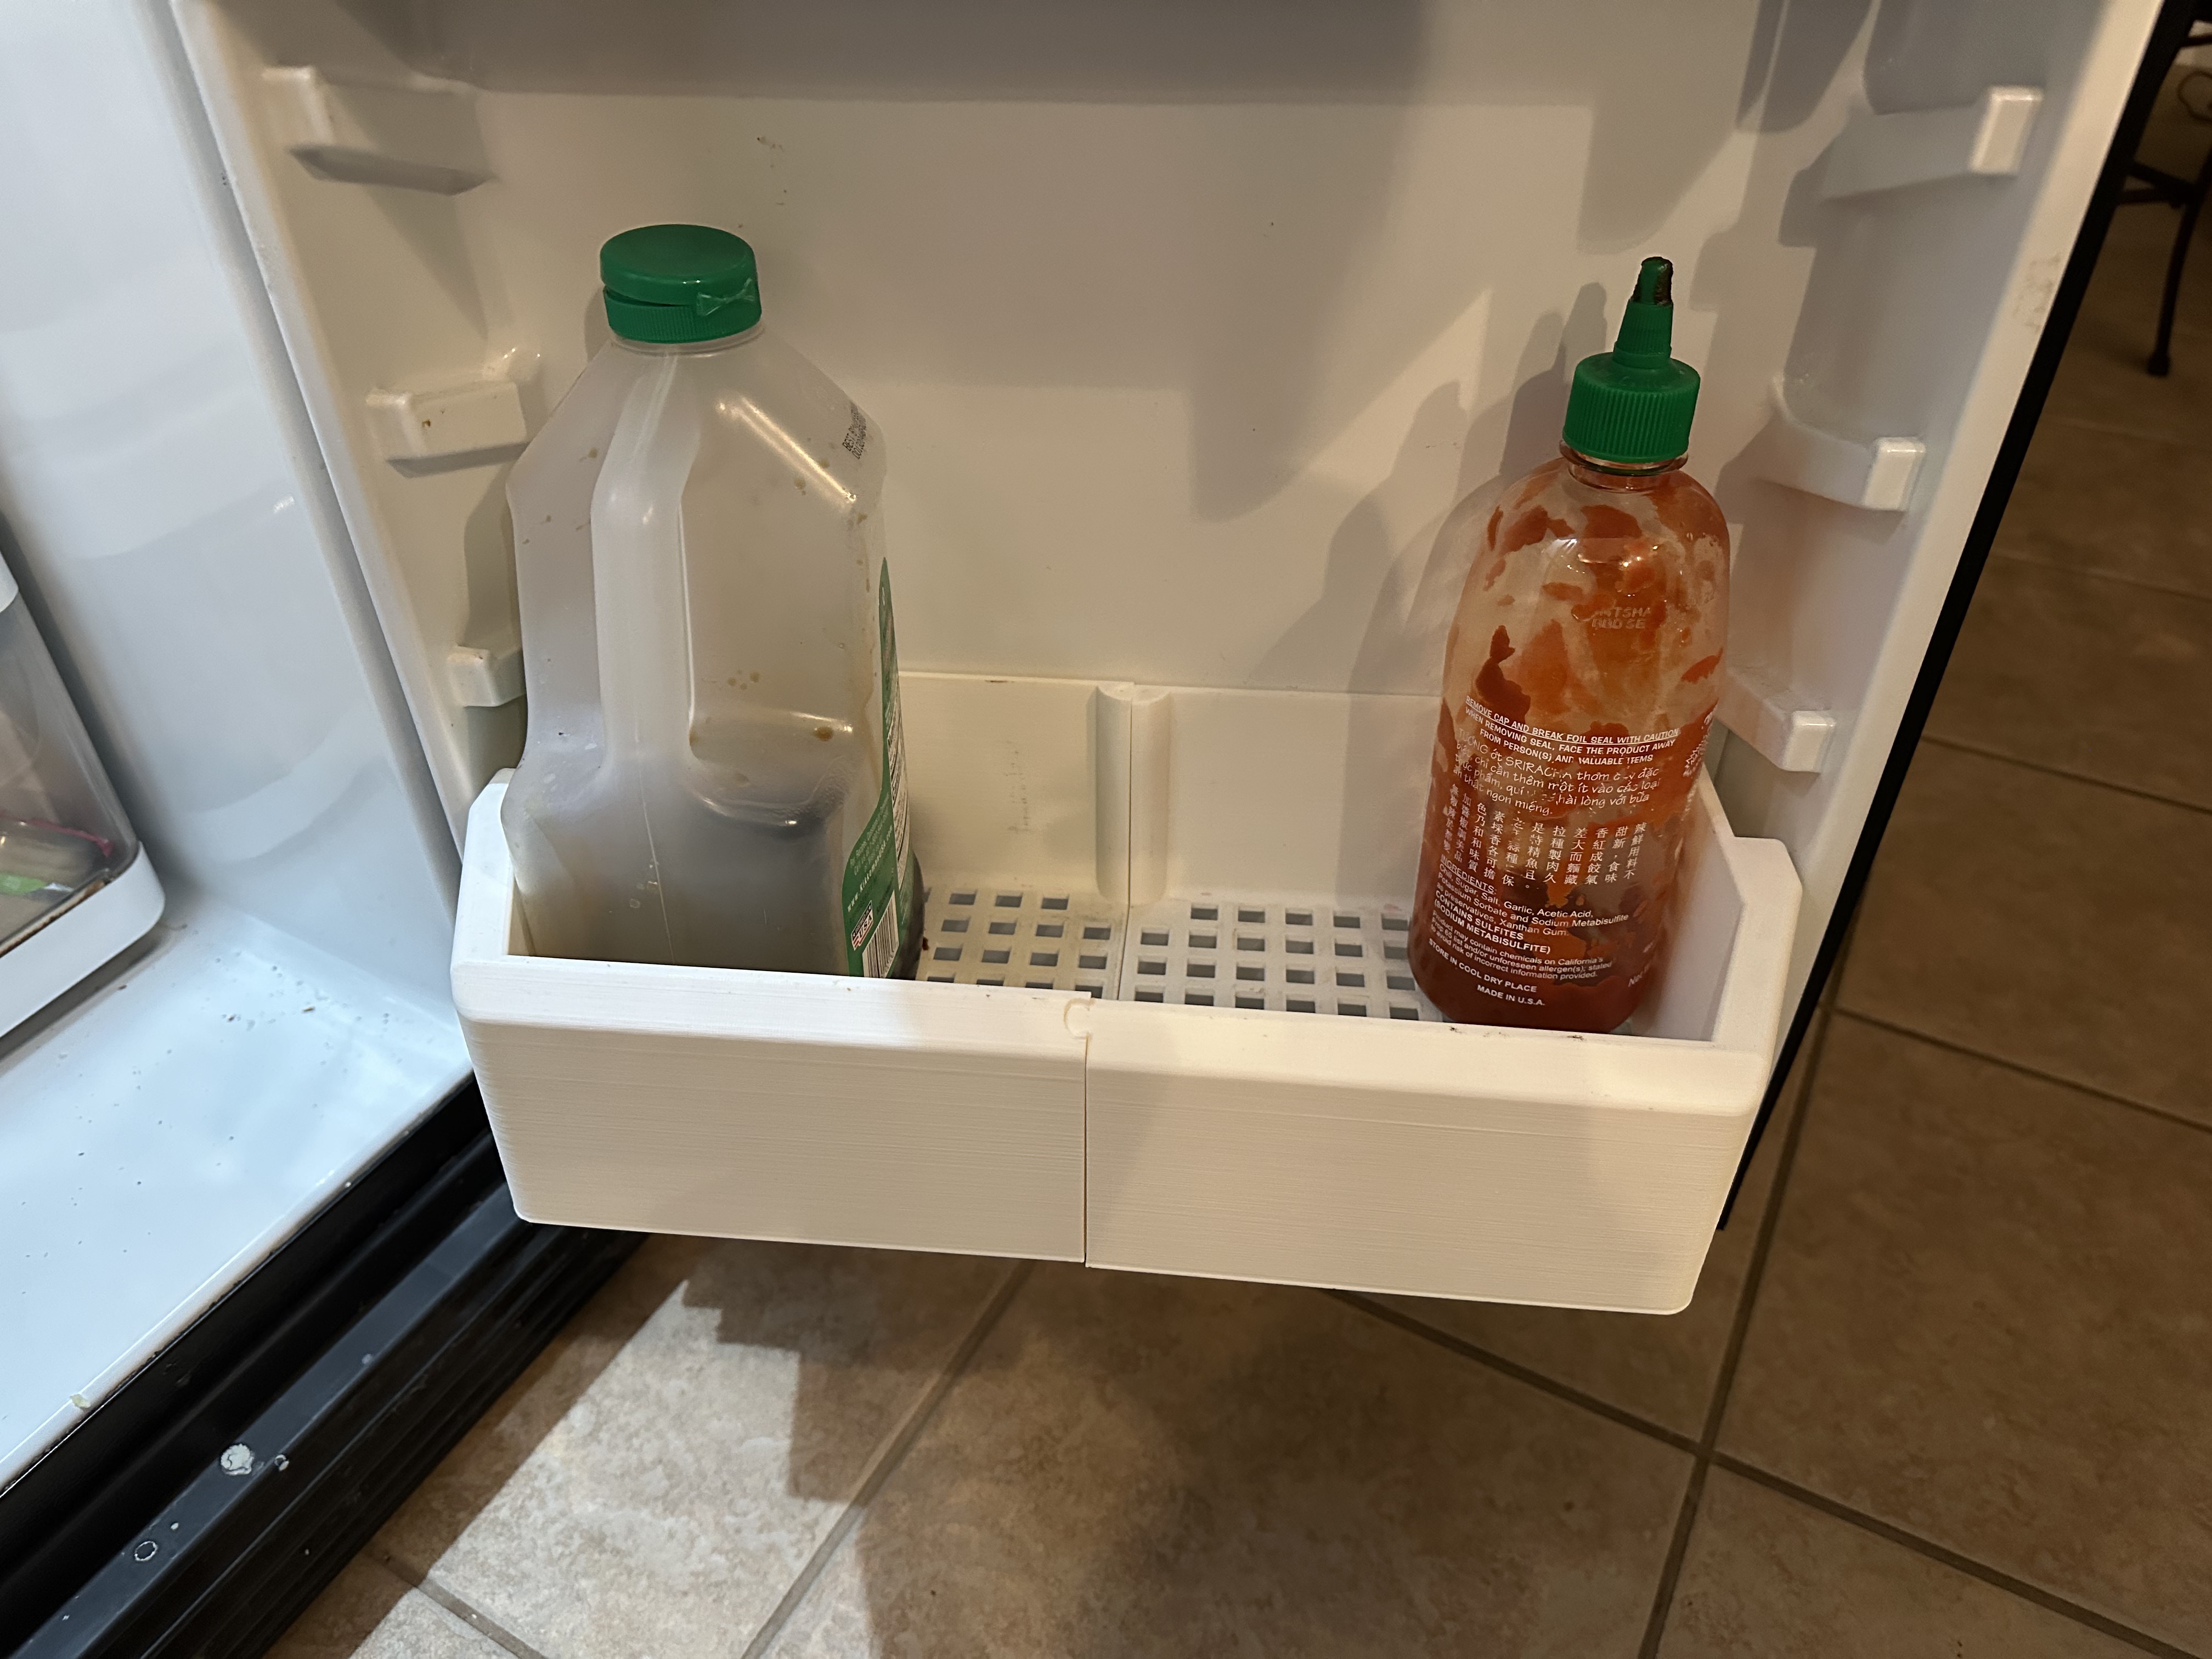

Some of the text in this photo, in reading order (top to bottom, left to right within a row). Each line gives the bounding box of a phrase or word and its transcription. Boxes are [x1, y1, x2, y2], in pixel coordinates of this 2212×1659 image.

[1465, 707, 1483, 724] WHEN
[1485, 720, 1527, 743] REMOVING
[1559, 744, 1583, 753] FACE
[1606, 744, 1650, 755] PRODUCT
[1651, 739, 1676, 751] AWAY
[1466, 696, 1492, 718] REMOVE
[1494, 713, 1510, 725] CAP
[1511, 721, 1530, 732] AND
[1532, 727, 1564, 741] BREAK
[1566, 734, 1587, 743] FOIL
[1643, 728, 1681, 742] CAUTION
[1480, 729, 1501, 745] FROM
[1503, 740, 1552, 762] PERSON(S)
[1486, 788, 1511, 805] ngon
[1513, 772, 1544, 788] thêm
[1441, 854, 1497, 895] INGREDIENTS:
[1455, 877, 1479, 898] Sugar,
[1481, 892, 1500, 906] Salt,
[1504, 901, 1534, 915] Garlic,
[1537, 909, 1568, 918] Acetic
[1436, 890, 1523, 940] CONTAINS SULFITES
[1438, 872, 1629, 927] Potassium Sorbate and Sodium Metabisulfite
[1444, 890, 1496, 924] preservatives,
[1499, 918, 1539, 934] Xanthan
[1543, 928, 1570, 936] Gum.
[859, 915, 872, 938] USA
[1432, 910, 1453, 932] Product
[1454, 929, 1468, 942] may
[1470, 939, 1497, 954] contain
[1499, 950, 1542, 964] chemicals
[1558, 956, 1603, 966] California's
[1432, 917, 1443, 932] Prop
[1444, 929, 1452, 939] 65
[1453, 935, 1463, 946] list
[1464, 943, 1488, 958] and/or
[1489, 954, 1536, 970] unforeseen
[1588, 961, 1612, 972] stated
[1434, 898, 1551, 955] (SODIUM METABISULFITE)
[1429, 938, 1537, 992] STORE IN COOL DRY PLACE
[1436, 930, 1452, 946] avoid
[1452, 943, 1464, 954] risk
[1475, 955, 1509, 973] incorrect
[1510, 967, 1558, 979] information
[1560, 971, 1598, 980] provided.
[1477, 984, 1545, 1006] MADE IN U.S.A.
